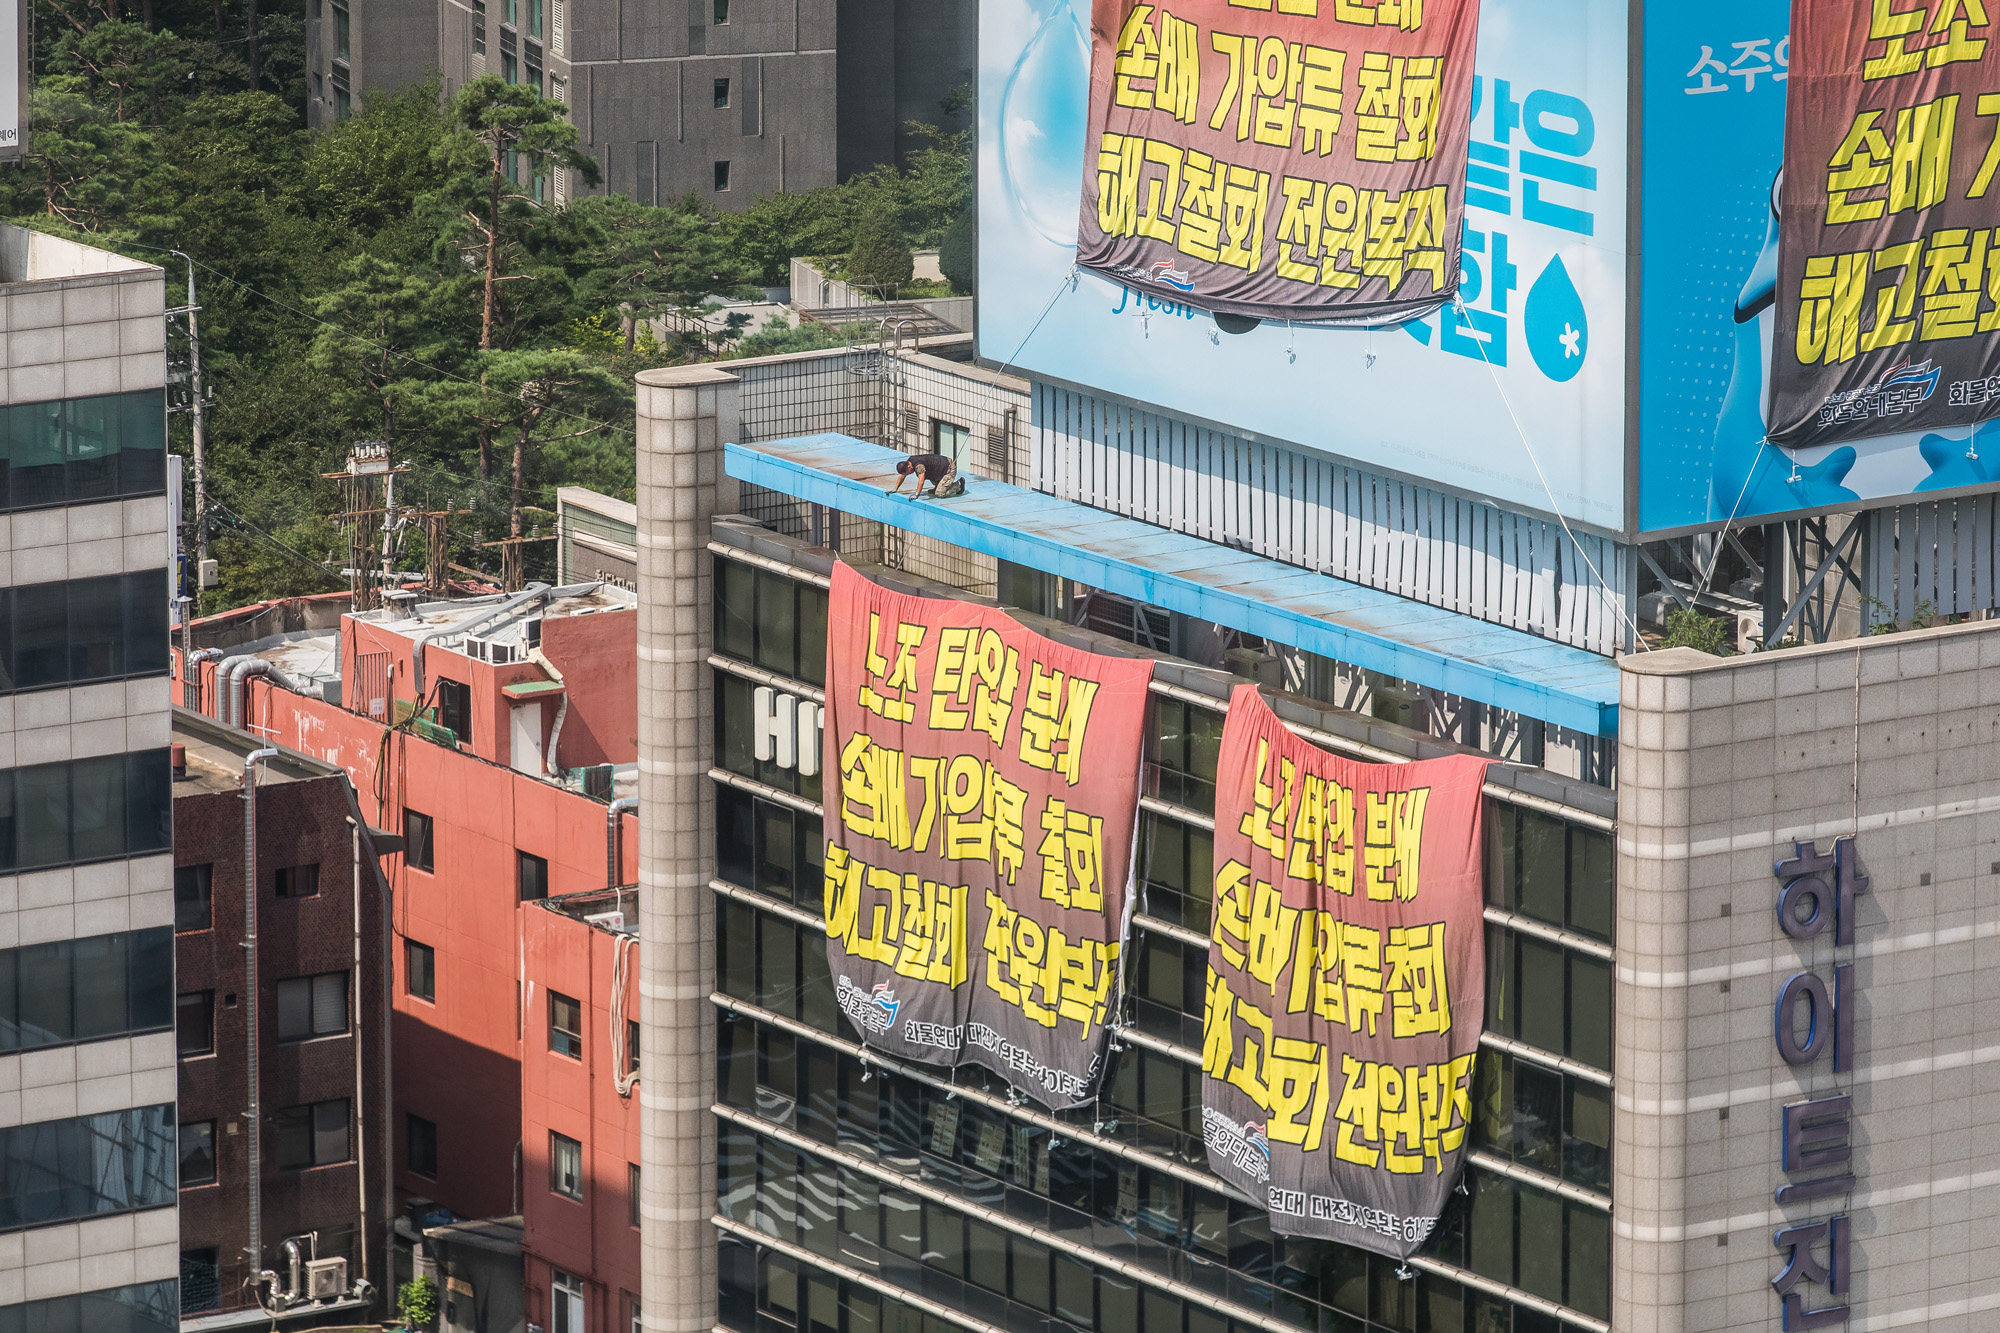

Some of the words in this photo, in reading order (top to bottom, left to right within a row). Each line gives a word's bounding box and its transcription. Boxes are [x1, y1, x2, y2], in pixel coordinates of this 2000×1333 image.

[1115, 4, 1199, 126] 손배
[1208, 31, 1348, 157] 가압류
[1354, 51, 1445, 163] 철회
[1097, 131, 1272, 276] 해고철회
[1274, 176, 1450, 294] 전원복직
[1825, 93, 1962, 227] 손배
[1795, 226, 2000, 367] 해고철
[754, 686, 825, 777] HI
[929, 626, 1020, 750] 탄압
[824, 839, 969, 991] 해고철회
[904, 1018, 964, 1051] 화물연대
